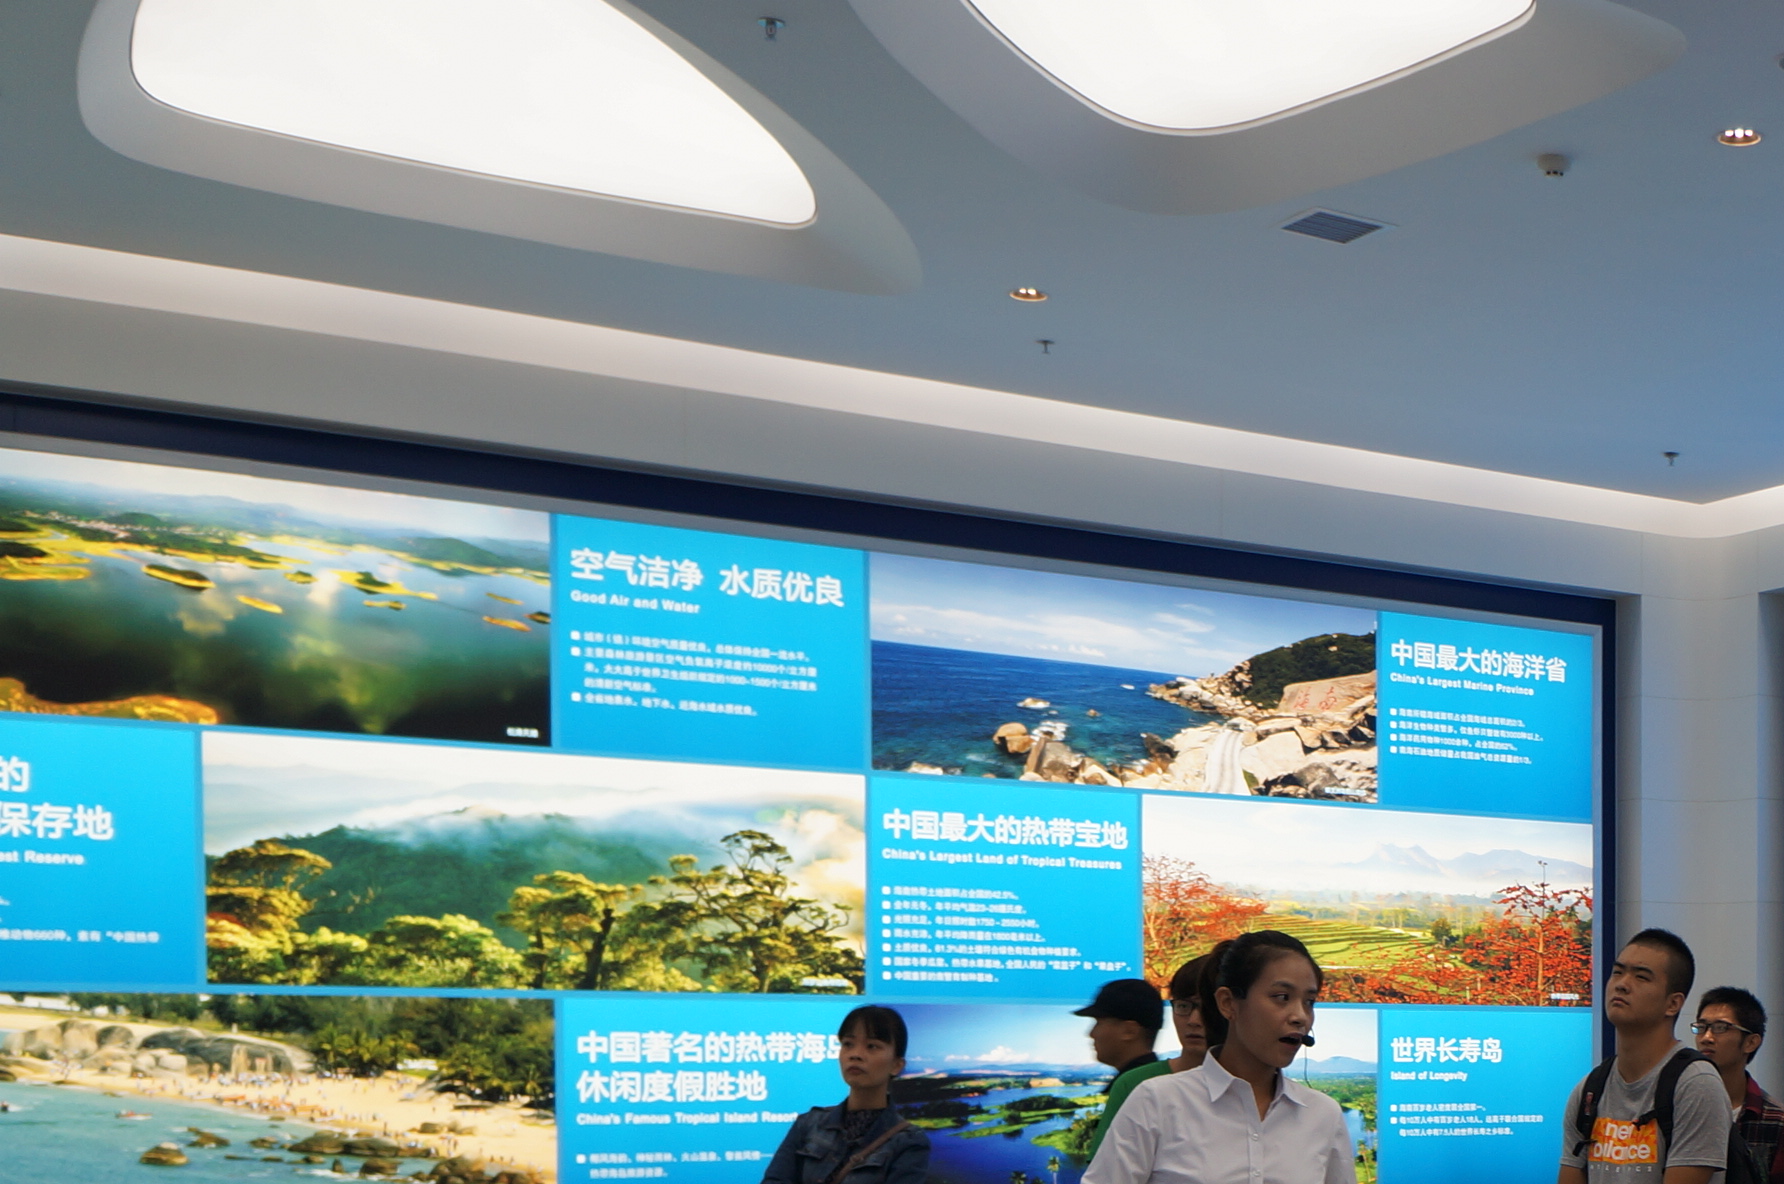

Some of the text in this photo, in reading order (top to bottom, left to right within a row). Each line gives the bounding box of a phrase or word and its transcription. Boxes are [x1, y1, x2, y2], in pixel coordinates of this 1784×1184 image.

[570, 548, 844, 607] 空气洁净 水质优良
[570, 590, 700, 613] Good Air and Water
[1390, 639, 1567, 683] 中国最大的海洋省
[1390, 672, 1534, 696] China's Largest Marine Province
[0, 756, 30, 792] 的
[0, 802, 114, 841] 保存地
[882, 808, 1128, 850] 中国最大的热带宝地
[25, 851, 85, 865] Reserve
[882, 848, 1122, 870] China's Largest Land of Tropical Treasures
[1390, 1036, 1503, 1064] 世界长寿岛
[576, 1070, 768, 1104] 休闲度假胜地
[1391, 1071, 1468, 1082] Island of Longevity
[576, 1112, 621, 1125] China's
[624, 1112, 671, 1125] Famous
[675, 1111, 720, 1126] Tropical
[724, 1111, 758, 1124] Island
